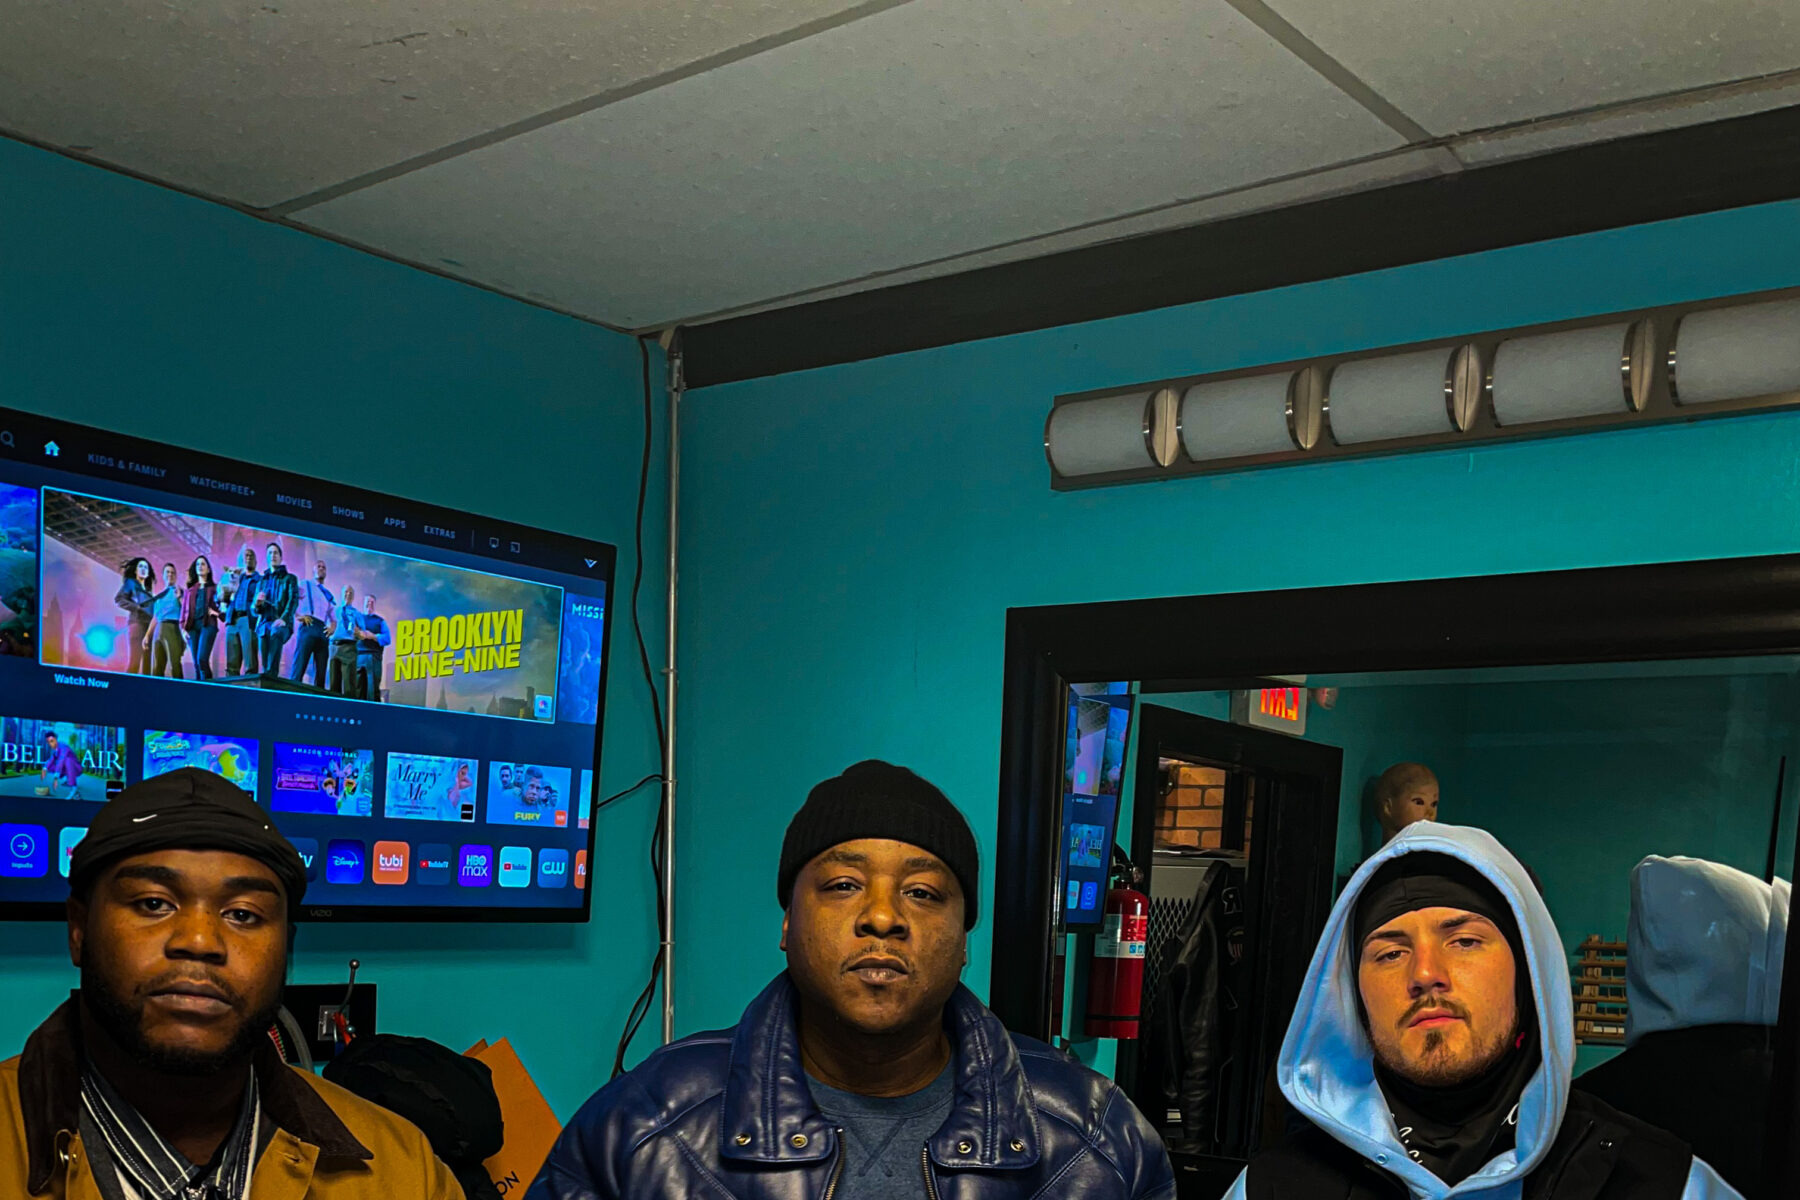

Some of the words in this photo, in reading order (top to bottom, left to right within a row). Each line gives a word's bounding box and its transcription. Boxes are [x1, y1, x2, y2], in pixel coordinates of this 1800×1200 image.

[87, 453, 115, 467] KIDS
[117, 459, 125, 469] &
[128, 462, 167, 478] FAMILY
[189, 474, 256, 496] WATCHFREE+
[276, 494, 313, 510] MOVIES
[332, 505, 365, 521] SHOWS
[383, 516, 406, 529] APPS
[423, 525, 456, 540] EXTRAS
[396, 609, 524, 657] BROOKLYN
[394, 643, 521, 682] NINE-NINE
[54, 673, 86, 687] Watch
[87, 677, 110, 689] Now
[1, 742, 49, 765] BEL
[81, 749, 124, 771] AIR
[393, 763, 441, 789] Marry
[403, 782, 428, 801] Me
[514, 811, 541, 821] FURY
[379, 853, 403, 868] tubi
[466, 854, 487, 866] HBO
[462, 865, 488, 877] max
